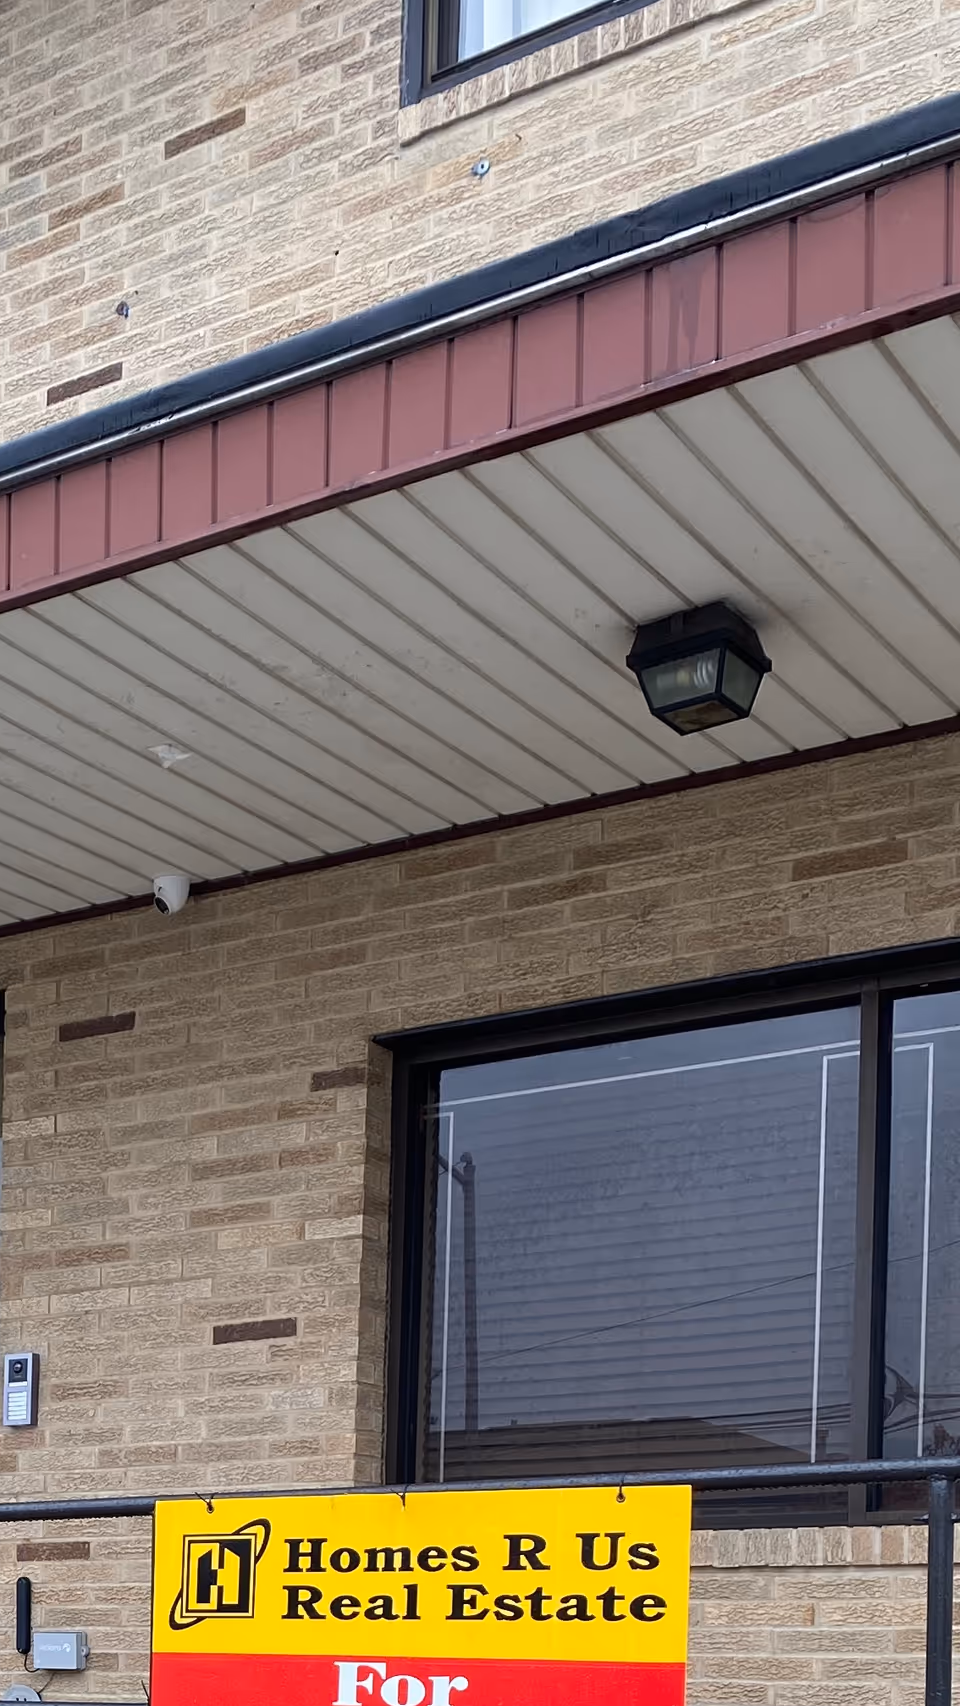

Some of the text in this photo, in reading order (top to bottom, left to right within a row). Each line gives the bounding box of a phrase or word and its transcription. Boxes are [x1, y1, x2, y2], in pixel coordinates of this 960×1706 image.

[283, 1532, 659, 1573] Homes R Us
[282, 1584, 667, 1621] Real Estate
